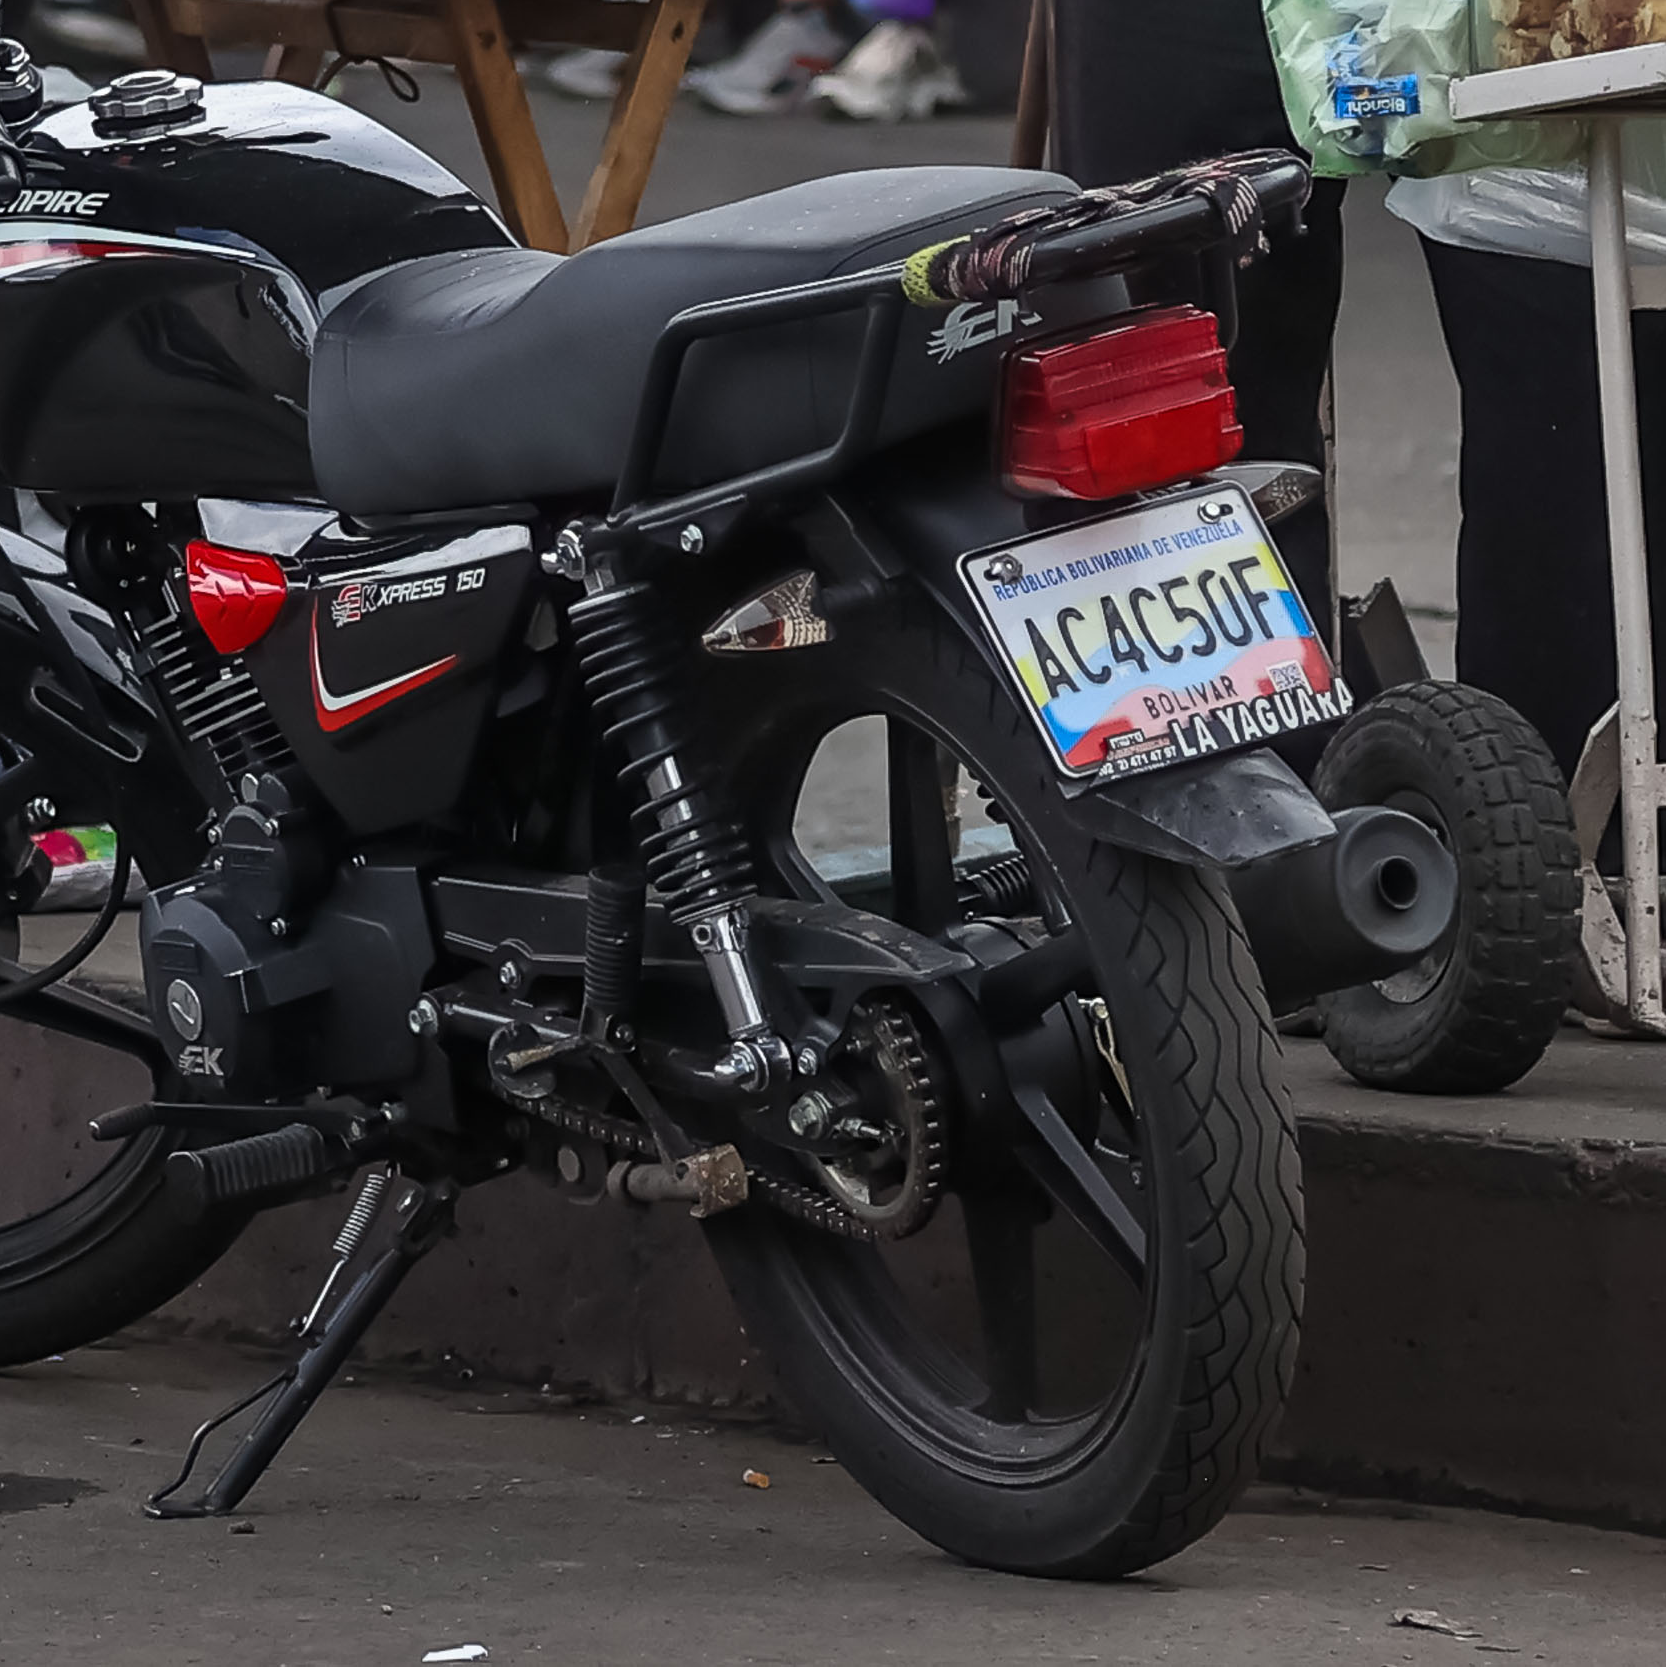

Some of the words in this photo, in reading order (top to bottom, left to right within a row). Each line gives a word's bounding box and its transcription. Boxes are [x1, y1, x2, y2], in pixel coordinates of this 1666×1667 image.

[1066, 545, 1153, 581] BOLIVARIANA
[1154, 535, 1173, 556] DE
[1171, 519, 1245, 553] VENEZUELA
[455, 567, 487, 592] 150
[1143, 674, 1239, 720] BOLIVAR
[1171, 713, 1219, 758] LA
